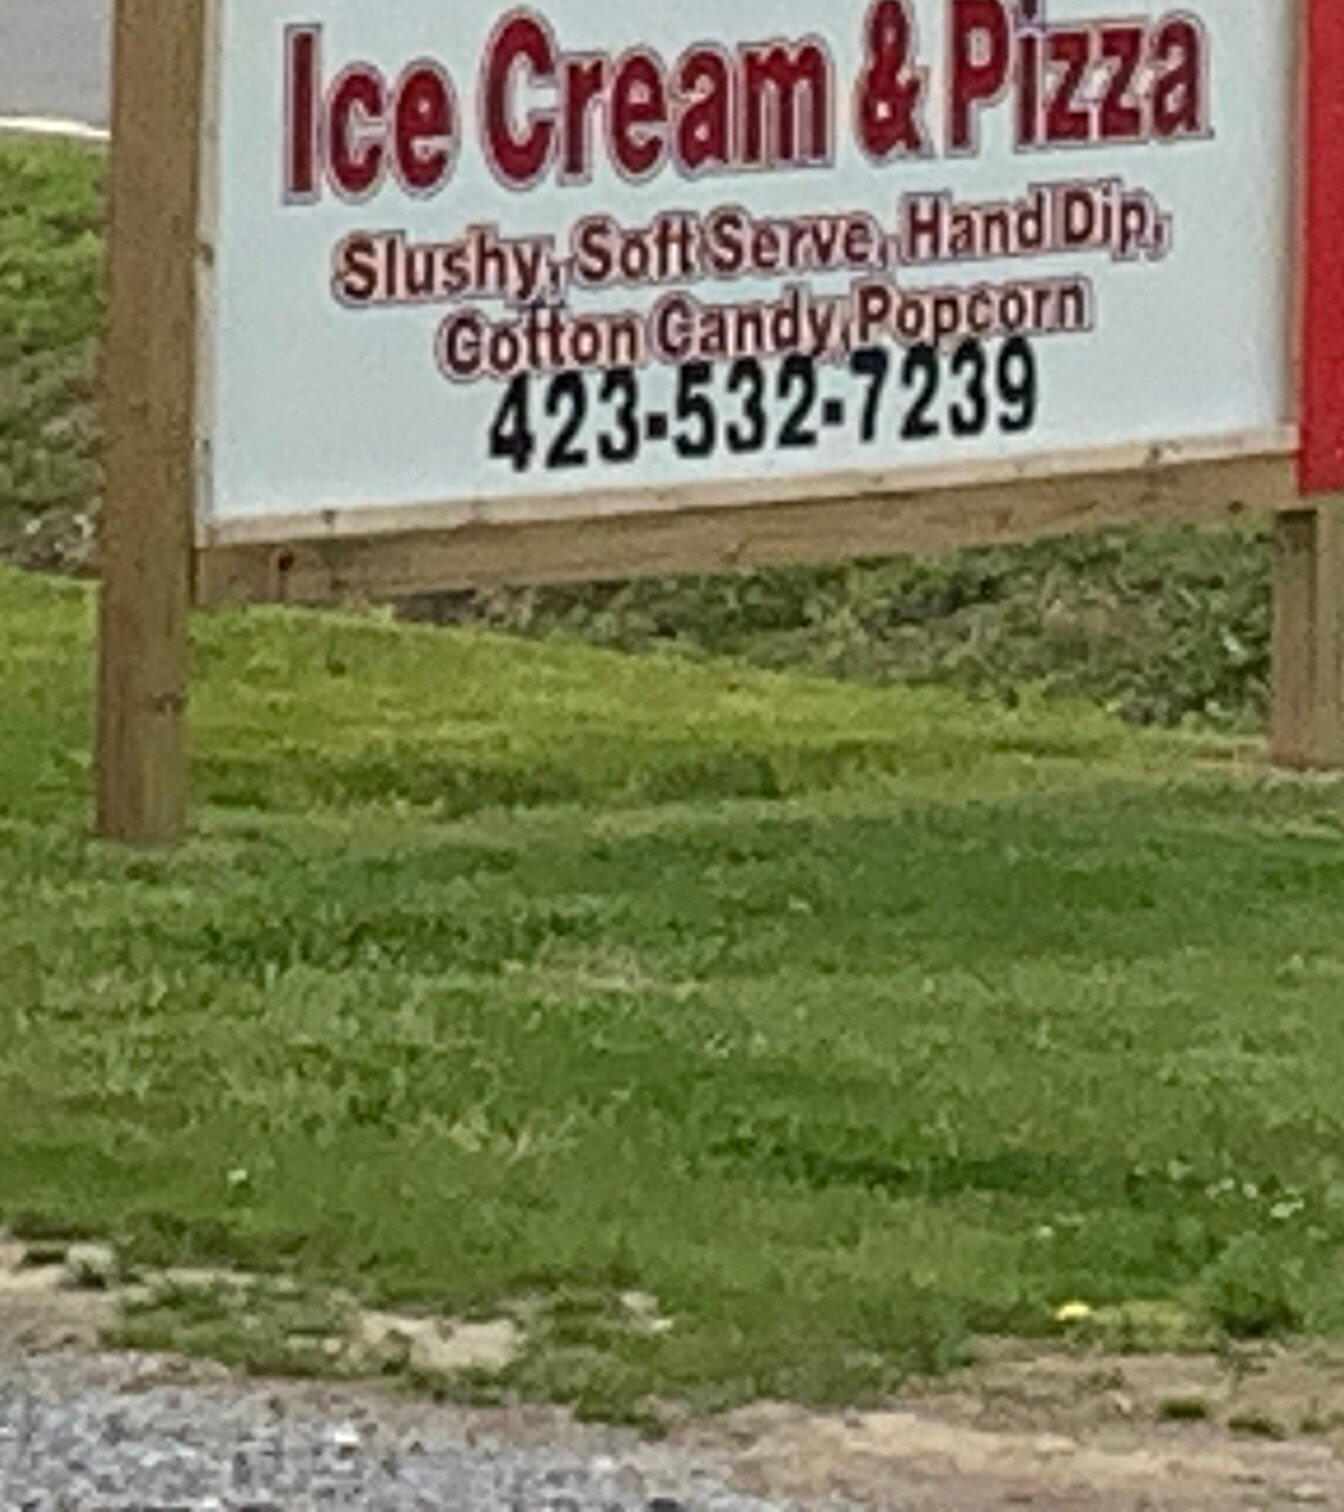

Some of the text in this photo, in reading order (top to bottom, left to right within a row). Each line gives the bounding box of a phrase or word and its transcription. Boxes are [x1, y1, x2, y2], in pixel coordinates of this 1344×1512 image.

[282, 23, 459, 206] Ice
[478, 5, 835, 192] Cream
[332, 178, 1173, 308] Slushy, Soft Serve, Hand Dip,
[434, 303, 649, 384] Cotton
[852, 275, 1096, 352] Popcorn
[488, 336, 1038, 474] 423-532-7239
